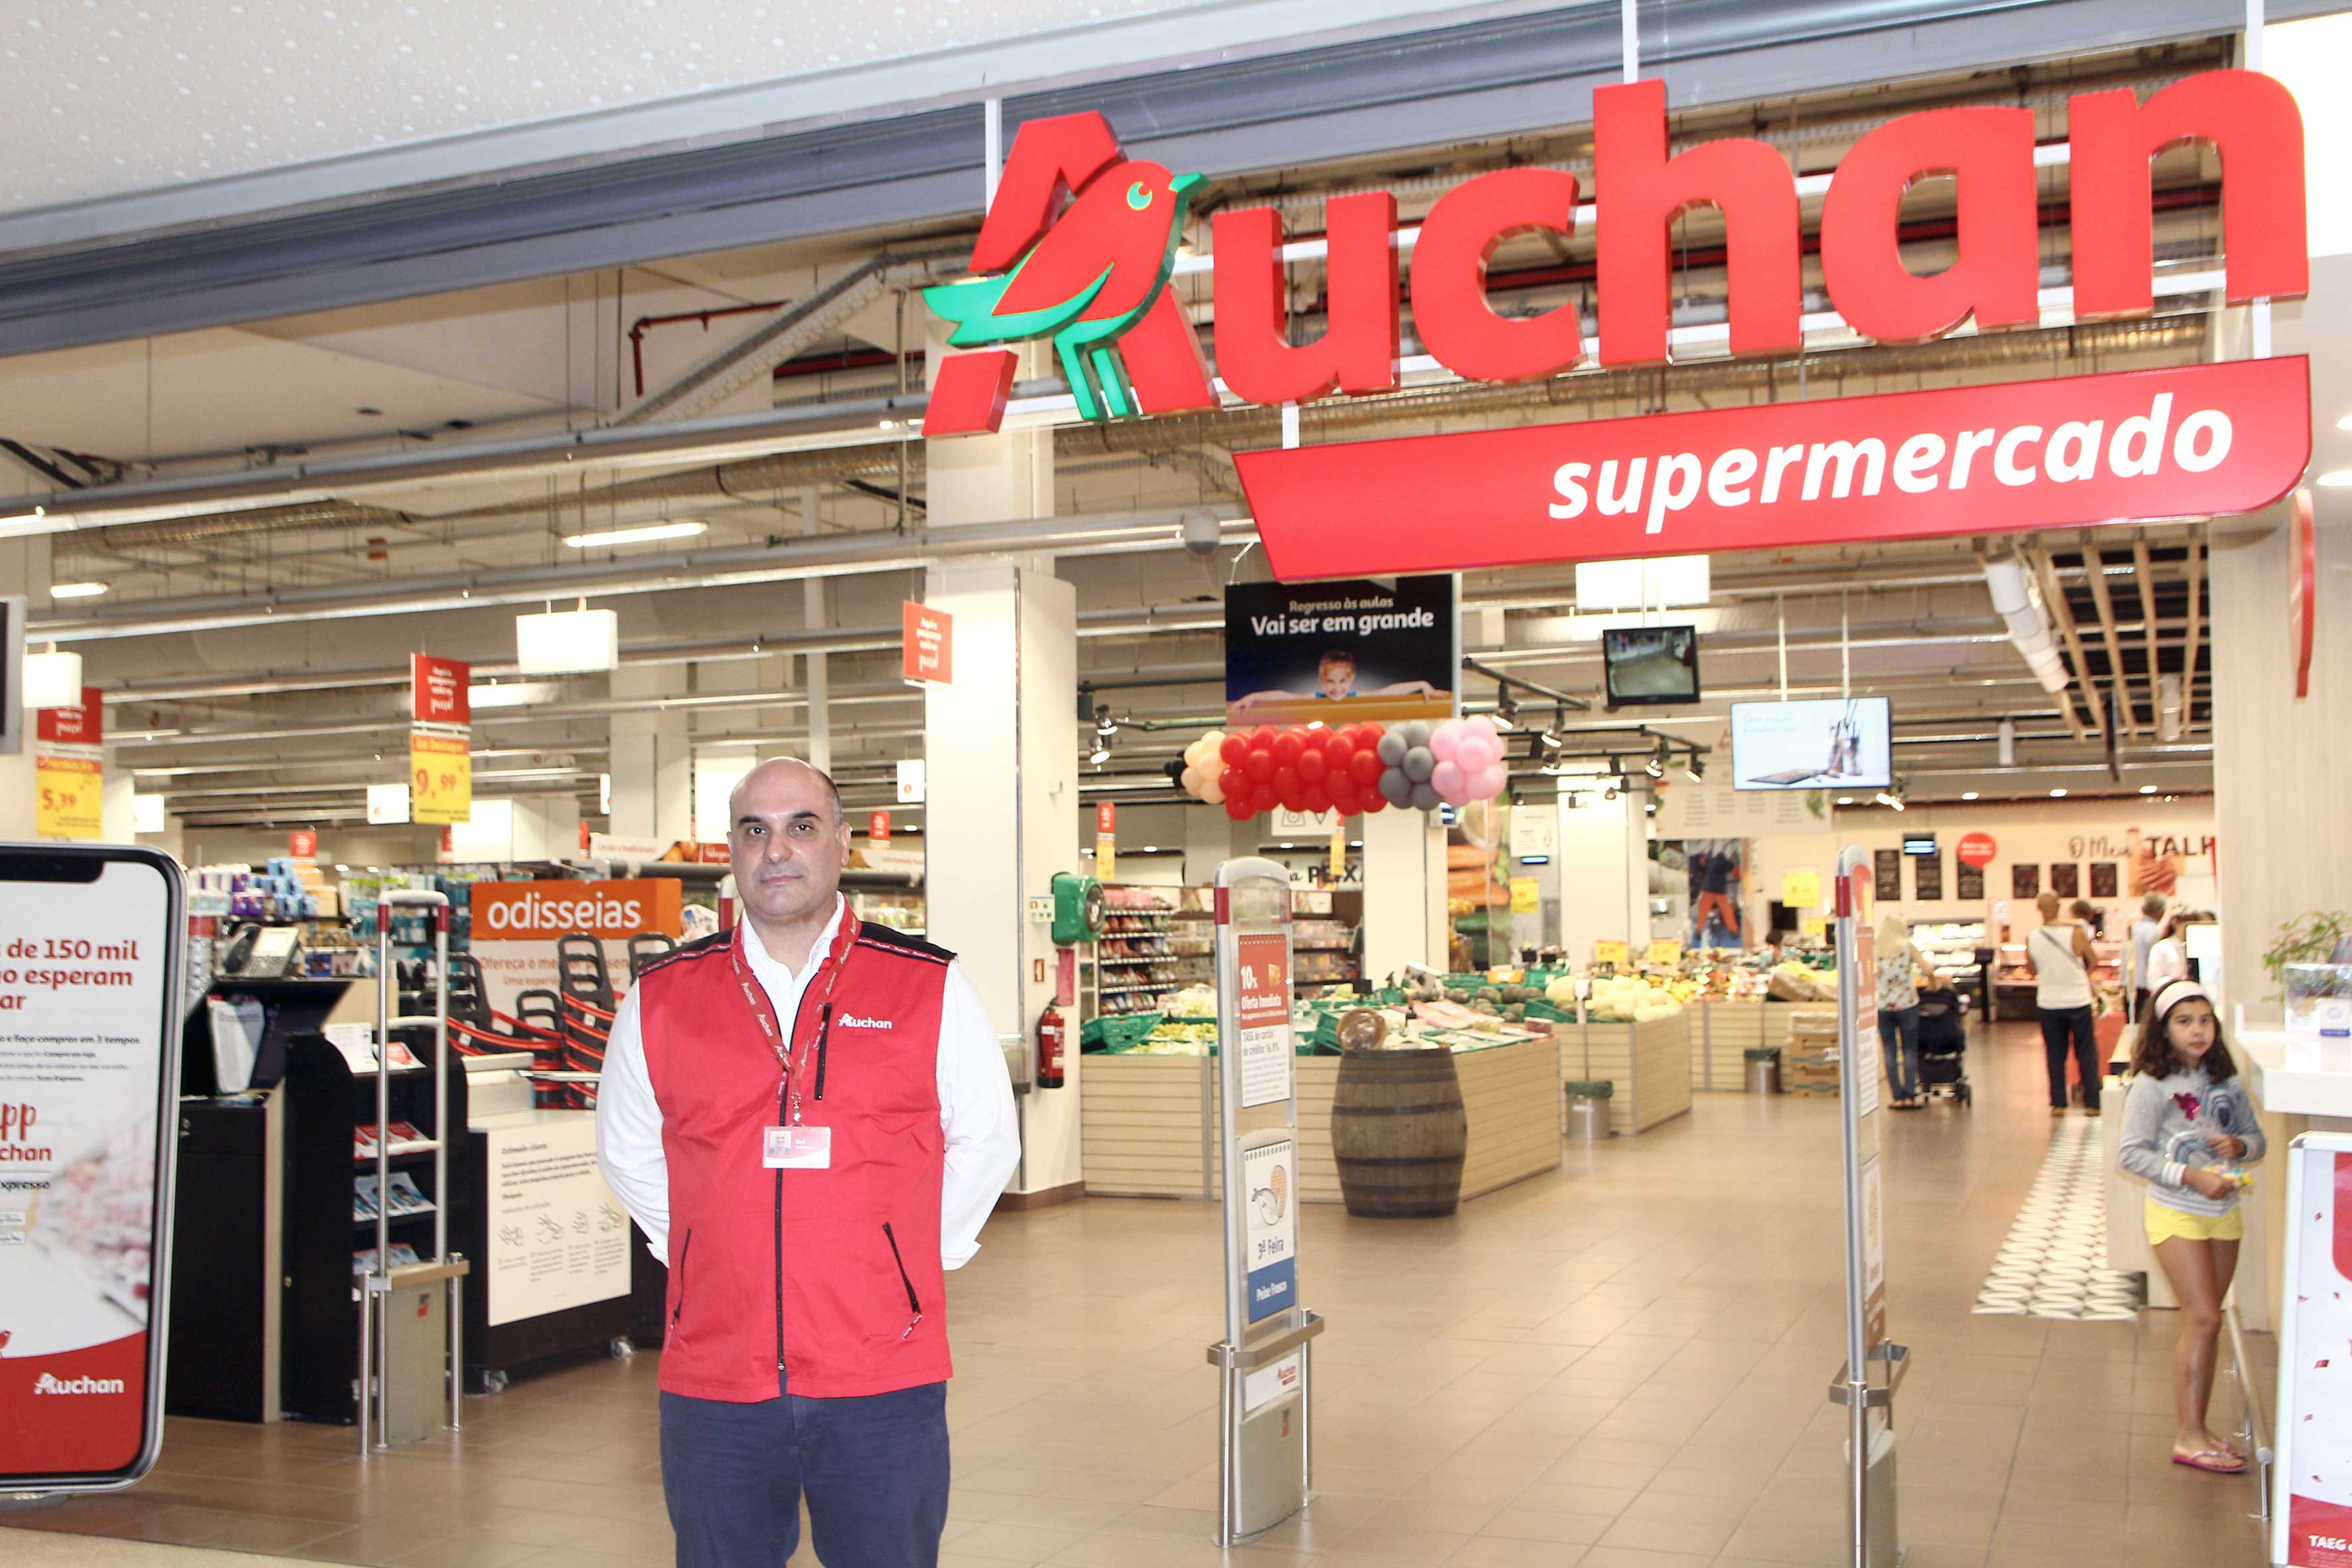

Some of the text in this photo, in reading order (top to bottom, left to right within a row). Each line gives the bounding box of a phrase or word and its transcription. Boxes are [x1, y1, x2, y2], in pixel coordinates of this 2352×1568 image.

[921, 66, 2310, 436] Auchan
[1548, 392, 2233, 535] supermercado
[1289, 595, 1393, 614] Regresso às aulas
[1251, 606, 1434, 636] Vai ser em grande
[488, 892, 641, 929] odisseias
[7, 938, 139, 961] de 150 mil
[25, 970, 133, 990] esperam
[838, 1013, 892, 1030] Auchan
[105, 1036, 140, 1046] tempos
[1268, 1237, 1285, 1255] Feira
[34, 1372, 125, 1395] Auchan
[2308, 1534, 2347, 1551] TAEG
